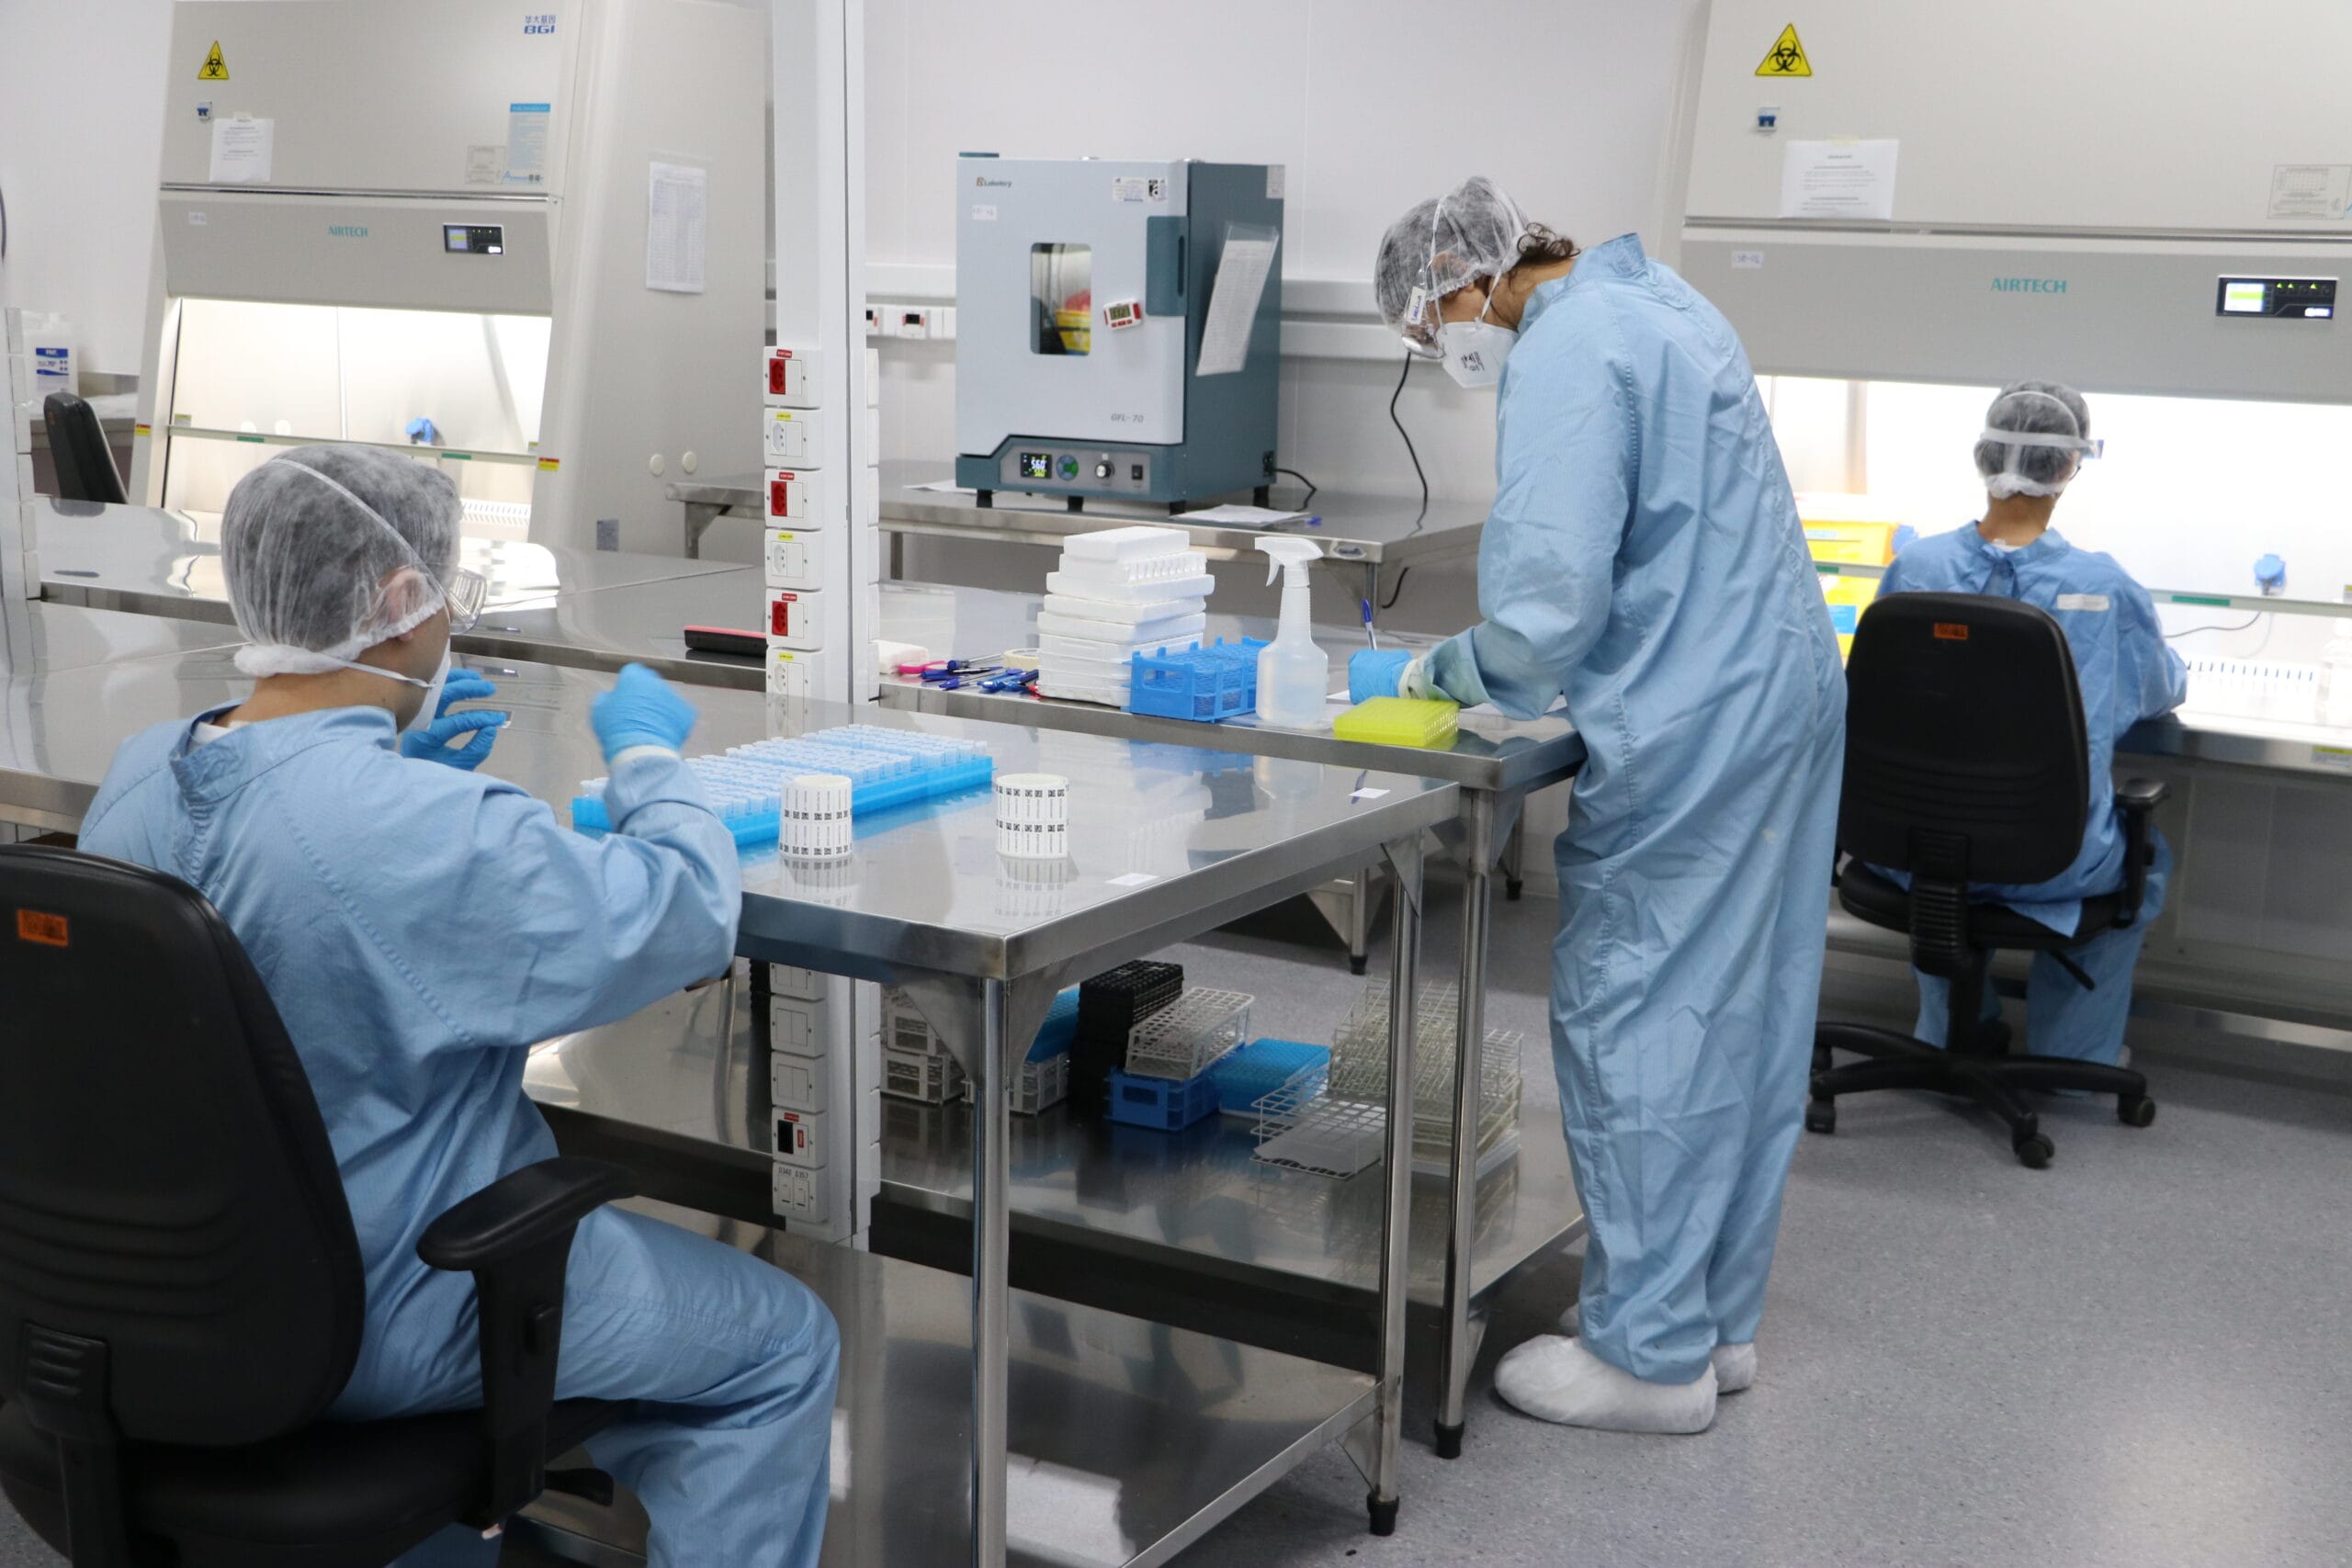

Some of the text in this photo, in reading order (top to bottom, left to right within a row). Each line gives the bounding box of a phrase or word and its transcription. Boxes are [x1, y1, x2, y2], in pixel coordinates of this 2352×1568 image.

[524, 25, 555, 34] BGI
[328, 226, 368, 237] AIRTECH
[1990, 278, 2067, 294] AIRTECH
